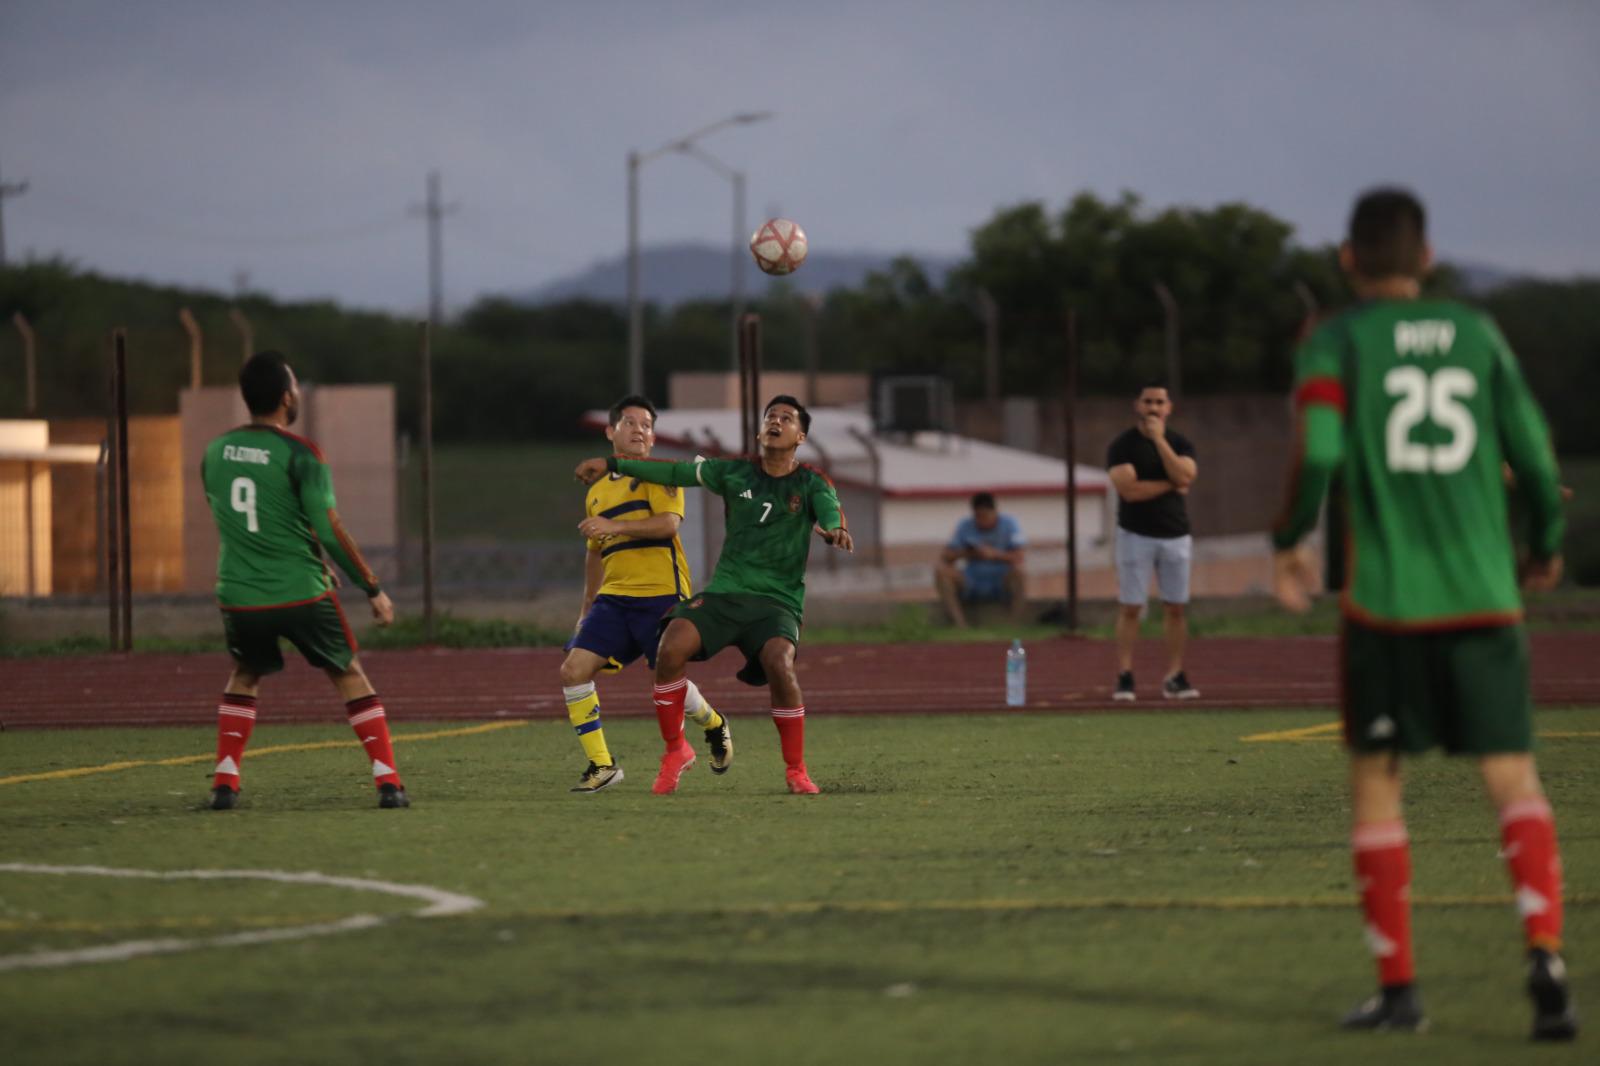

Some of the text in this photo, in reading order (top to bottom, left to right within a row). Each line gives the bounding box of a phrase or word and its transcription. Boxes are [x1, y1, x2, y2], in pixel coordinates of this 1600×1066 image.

[1384, 366, 1477, 473] 25
[230, 476, 259, 533] 9
[760, 502, 773, 523] 7
